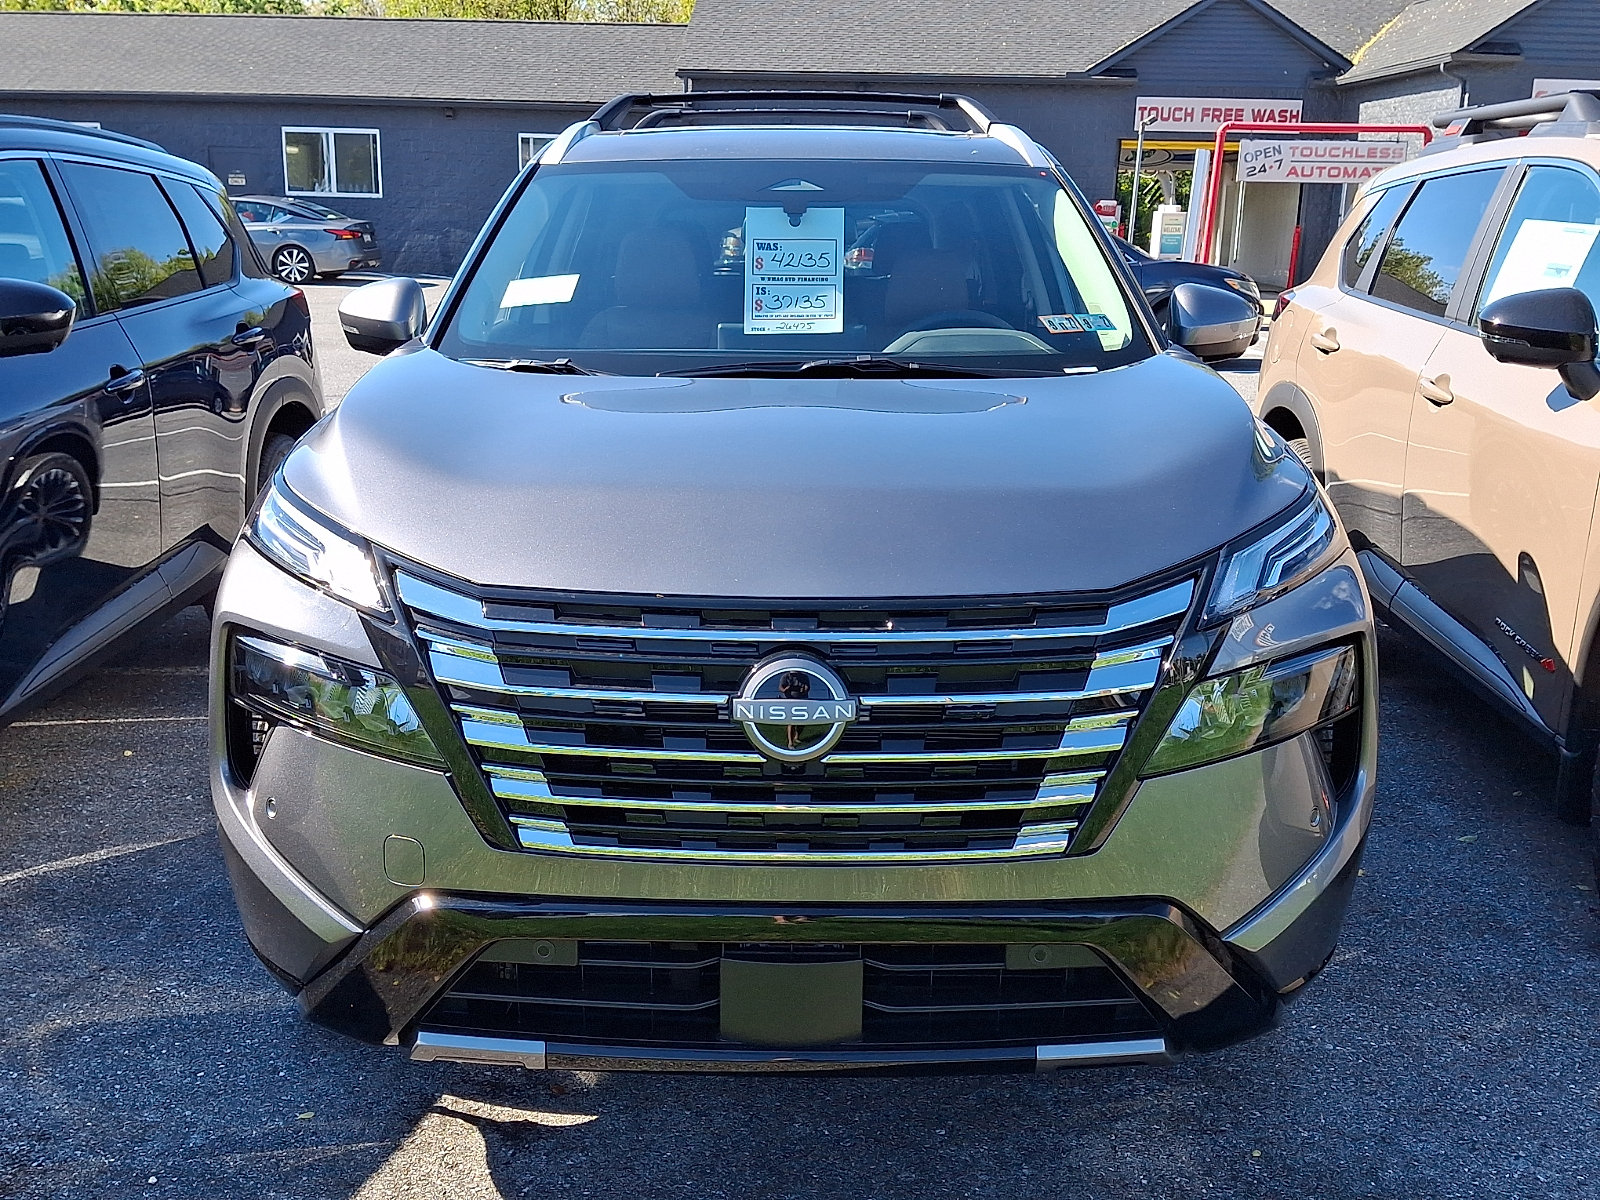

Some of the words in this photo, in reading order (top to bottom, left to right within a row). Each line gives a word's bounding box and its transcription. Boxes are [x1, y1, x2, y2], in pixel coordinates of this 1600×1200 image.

[1138, 105, 1195, 122] TOUCH
[1200, 107, 1245, 122] FREE
[1251, 108, 1300, 123] WASH
[1243, 144, 1282, 163] OPEN
[1288, 146, 1405, 159] TOUCHLESS
[756, 242, 782, 251] WAS:
[755, 256, 764, 272] $
[771, 252, 830, 268] 42135
[755, 286, 771, 295] IS:
[754, 298, 763, 313] $
[765, 295, 828, 310] 37135
[736, 703, 852, 720] NISSAN
